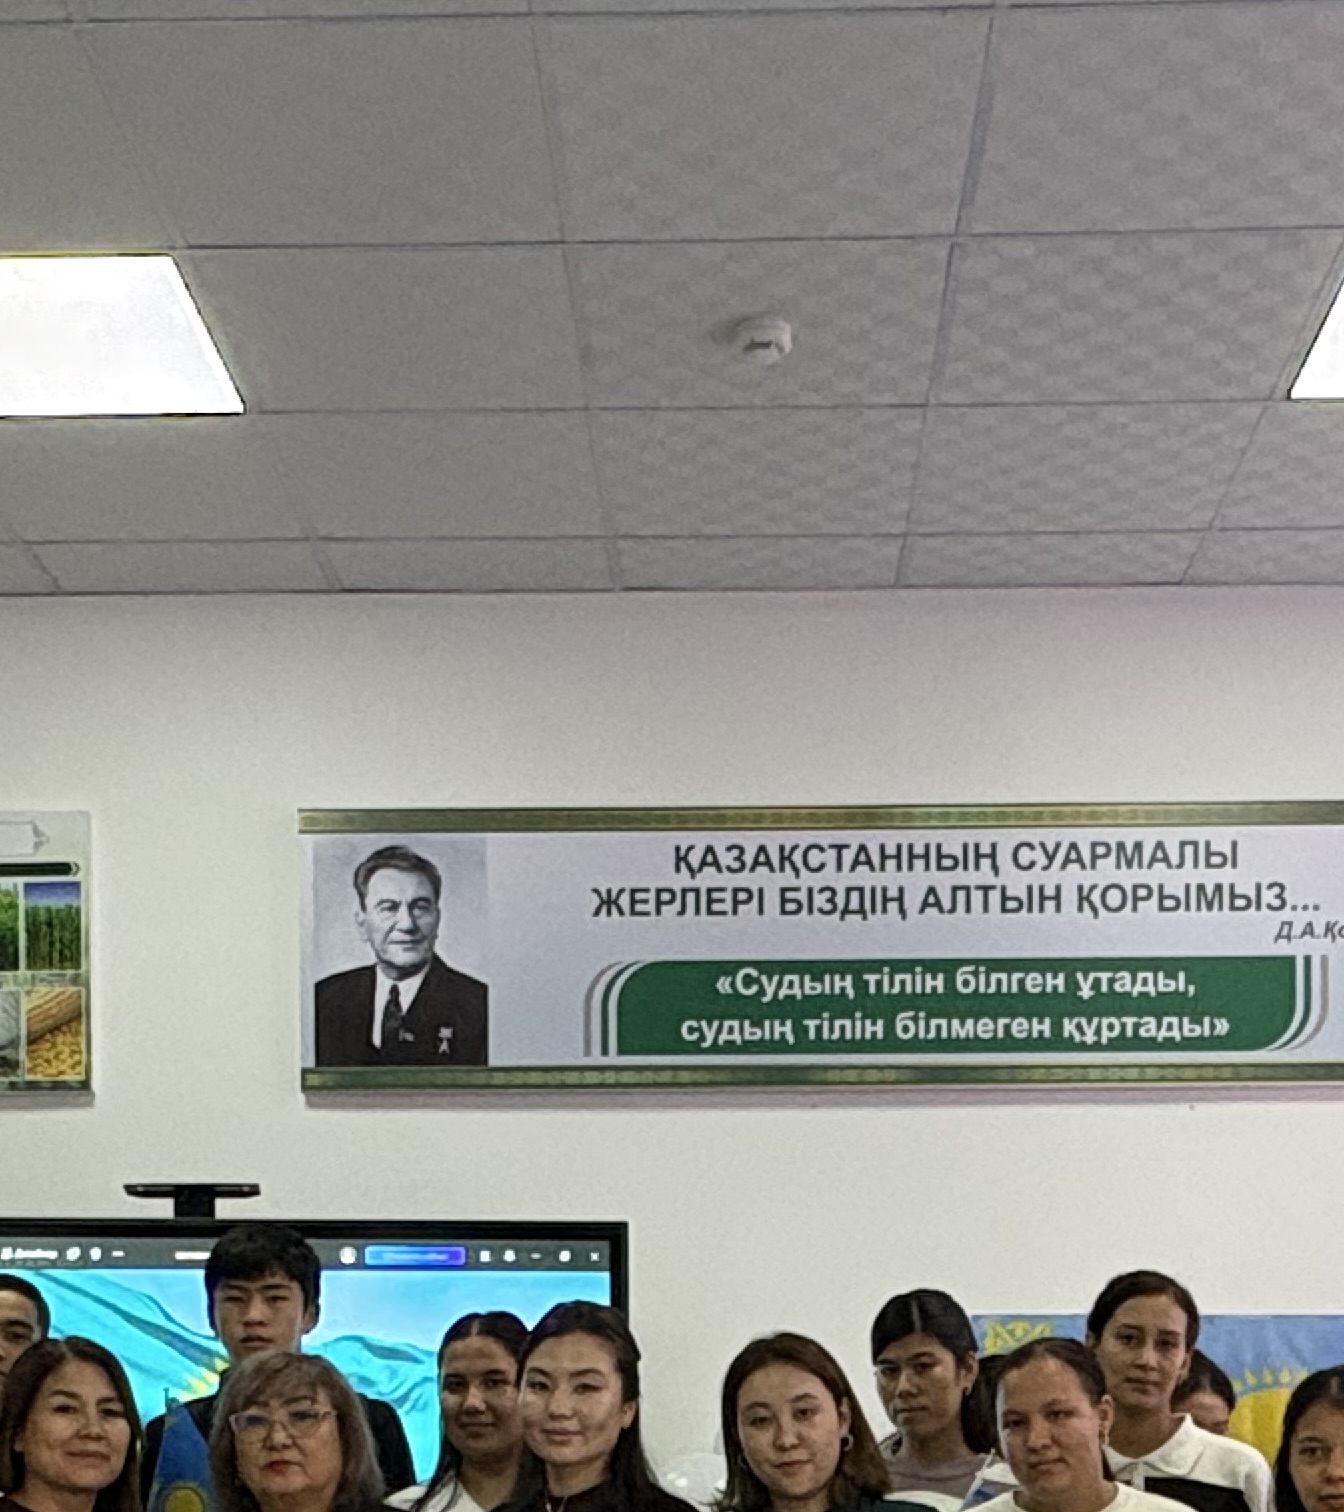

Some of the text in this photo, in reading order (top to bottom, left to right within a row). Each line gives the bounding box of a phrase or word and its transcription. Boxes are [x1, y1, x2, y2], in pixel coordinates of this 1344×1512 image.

[674, 840, 1238, 879] ҚАЗАҚСТАННЫҢ СУАРМАЛЫ
[592, 881, 1321, 921] ЖЕРЛЕРІ БІЗДІҢ АЛТЫН ҚОРЫМЫЗ...
[716, 965, 1195, 1003] «Судың тілін білген ұтады,
[681, 1011, 1230, 1048] судың тілін білмеген құртады»
